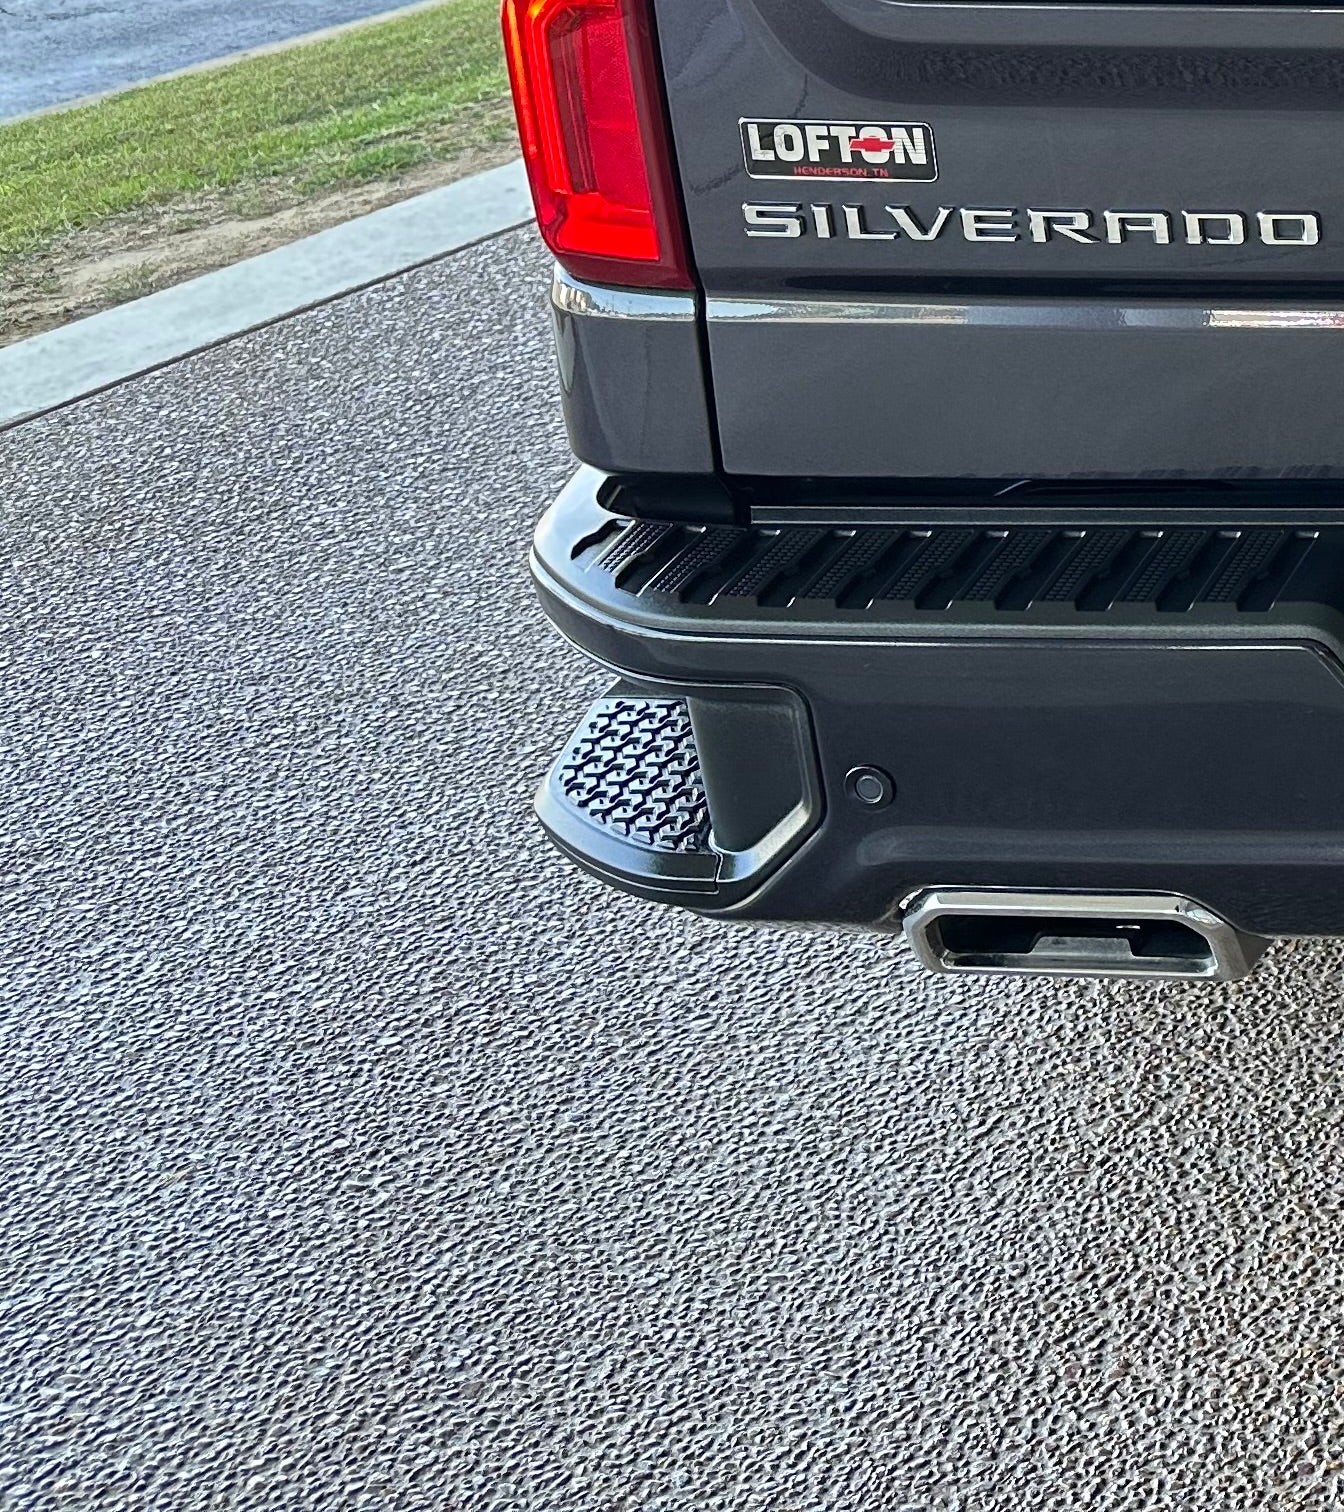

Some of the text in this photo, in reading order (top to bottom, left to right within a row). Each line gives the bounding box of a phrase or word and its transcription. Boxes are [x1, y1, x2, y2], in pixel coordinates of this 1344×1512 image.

[747, 123, 927, 165] LOFTON
[873, 167, 889, 178] TN
[741, 200, 1321, 247] SILVERADO
